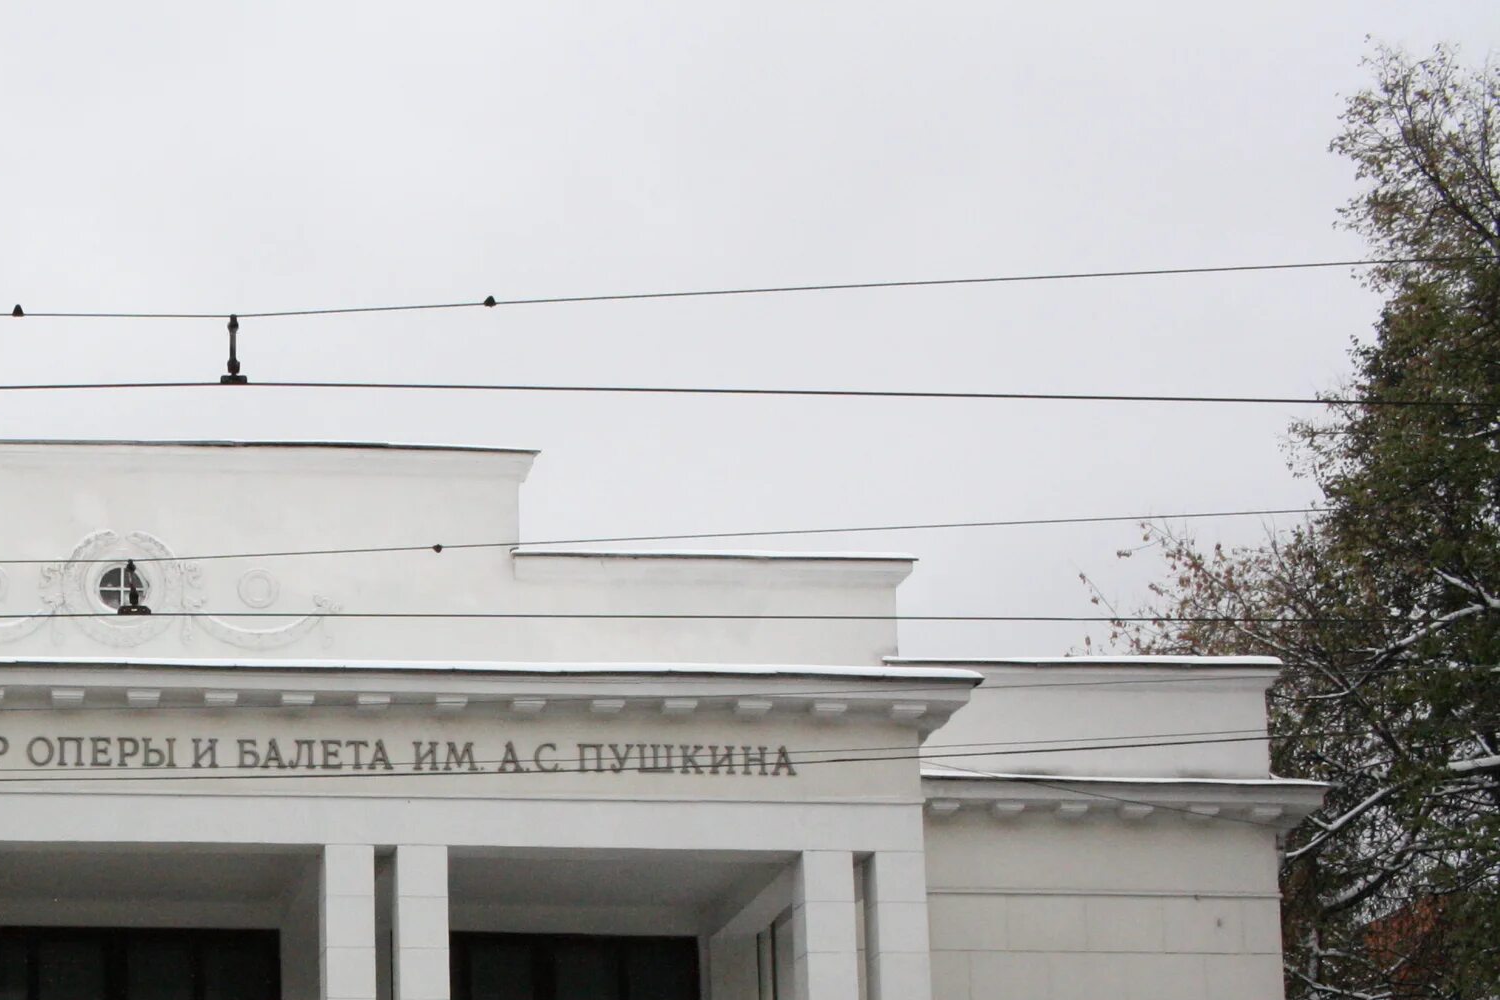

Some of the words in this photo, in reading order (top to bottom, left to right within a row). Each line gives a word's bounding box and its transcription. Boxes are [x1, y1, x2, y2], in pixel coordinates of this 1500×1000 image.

[26, 735, 177, 768] ОПЕРЫ
[191, 738, 220, 769] И
[237, 738, 394, 771] БАЛЕТА
[412, 740, 485, 772] ИМ.
[576, 742, 798, 776] ПУШКИНА
